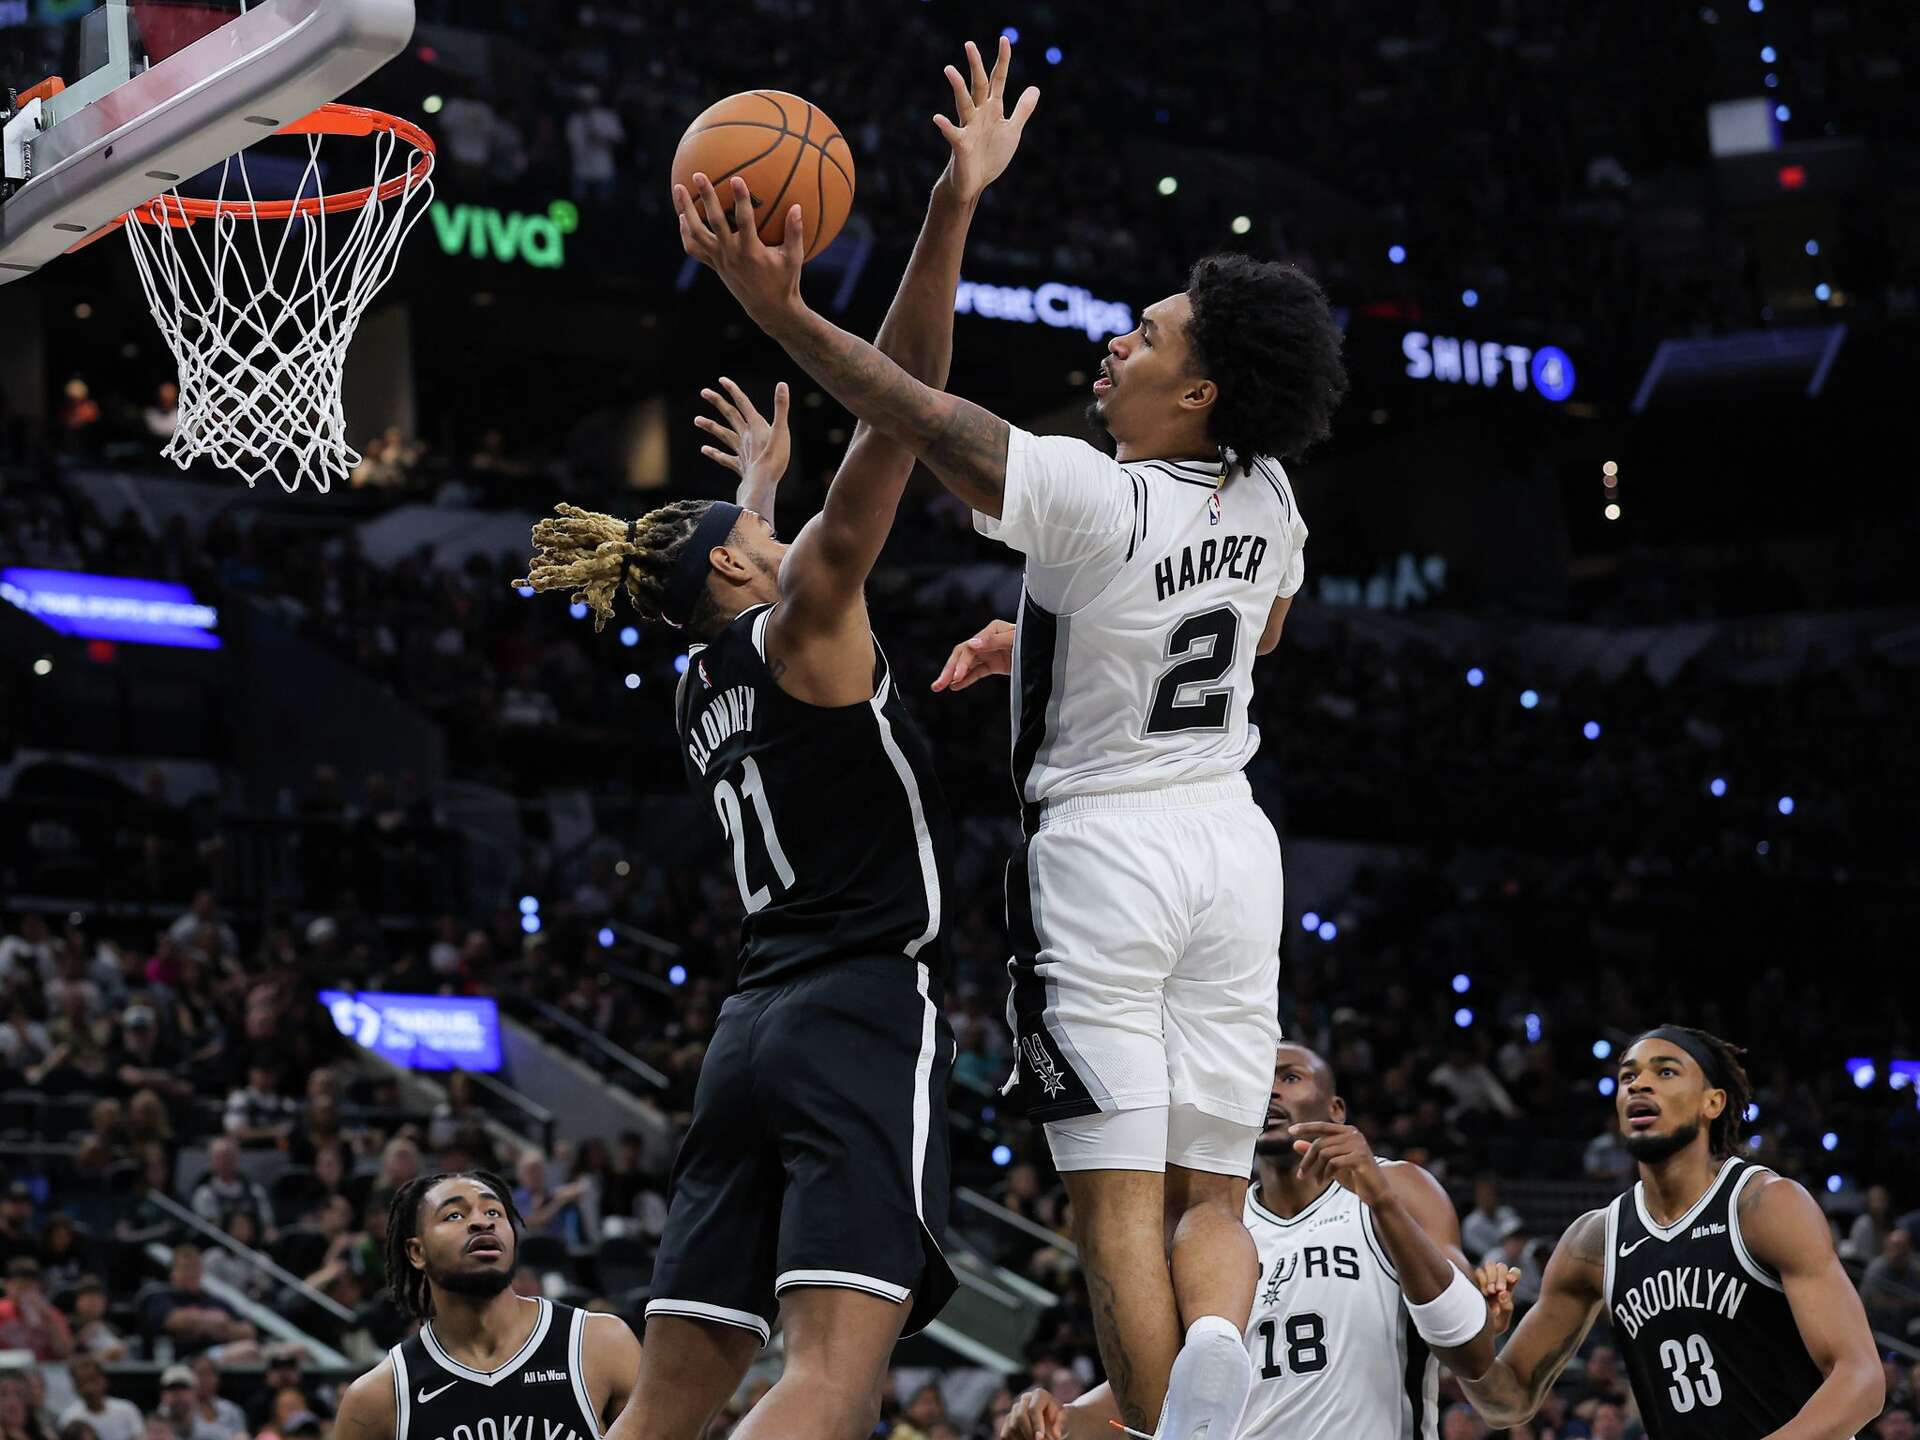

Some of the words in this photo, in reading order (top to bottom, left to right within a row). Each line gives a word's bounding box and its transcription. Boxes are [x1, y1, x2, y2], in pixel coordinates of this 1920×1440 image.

[955, 279, 1038, 324] reat
[1034, 281, 1134, 343] Clips
[1154, 534, 1268, 602] HARPER
[1140, 600, 1242, 739] 2
[689, 685, 755, 777] CLOWNEY
[713, 755, 796, 915] 21
[1615, 1266, 1749, 1341] BROOKLYN
[523, 1371, 536, 1384] All
[536, 1371, 547, 1383] In
[546, 1369, 567, 1381] Won
[1257, 1311, 1330, 1383] 18
[1659, 1333, 1723, 1414] 33
